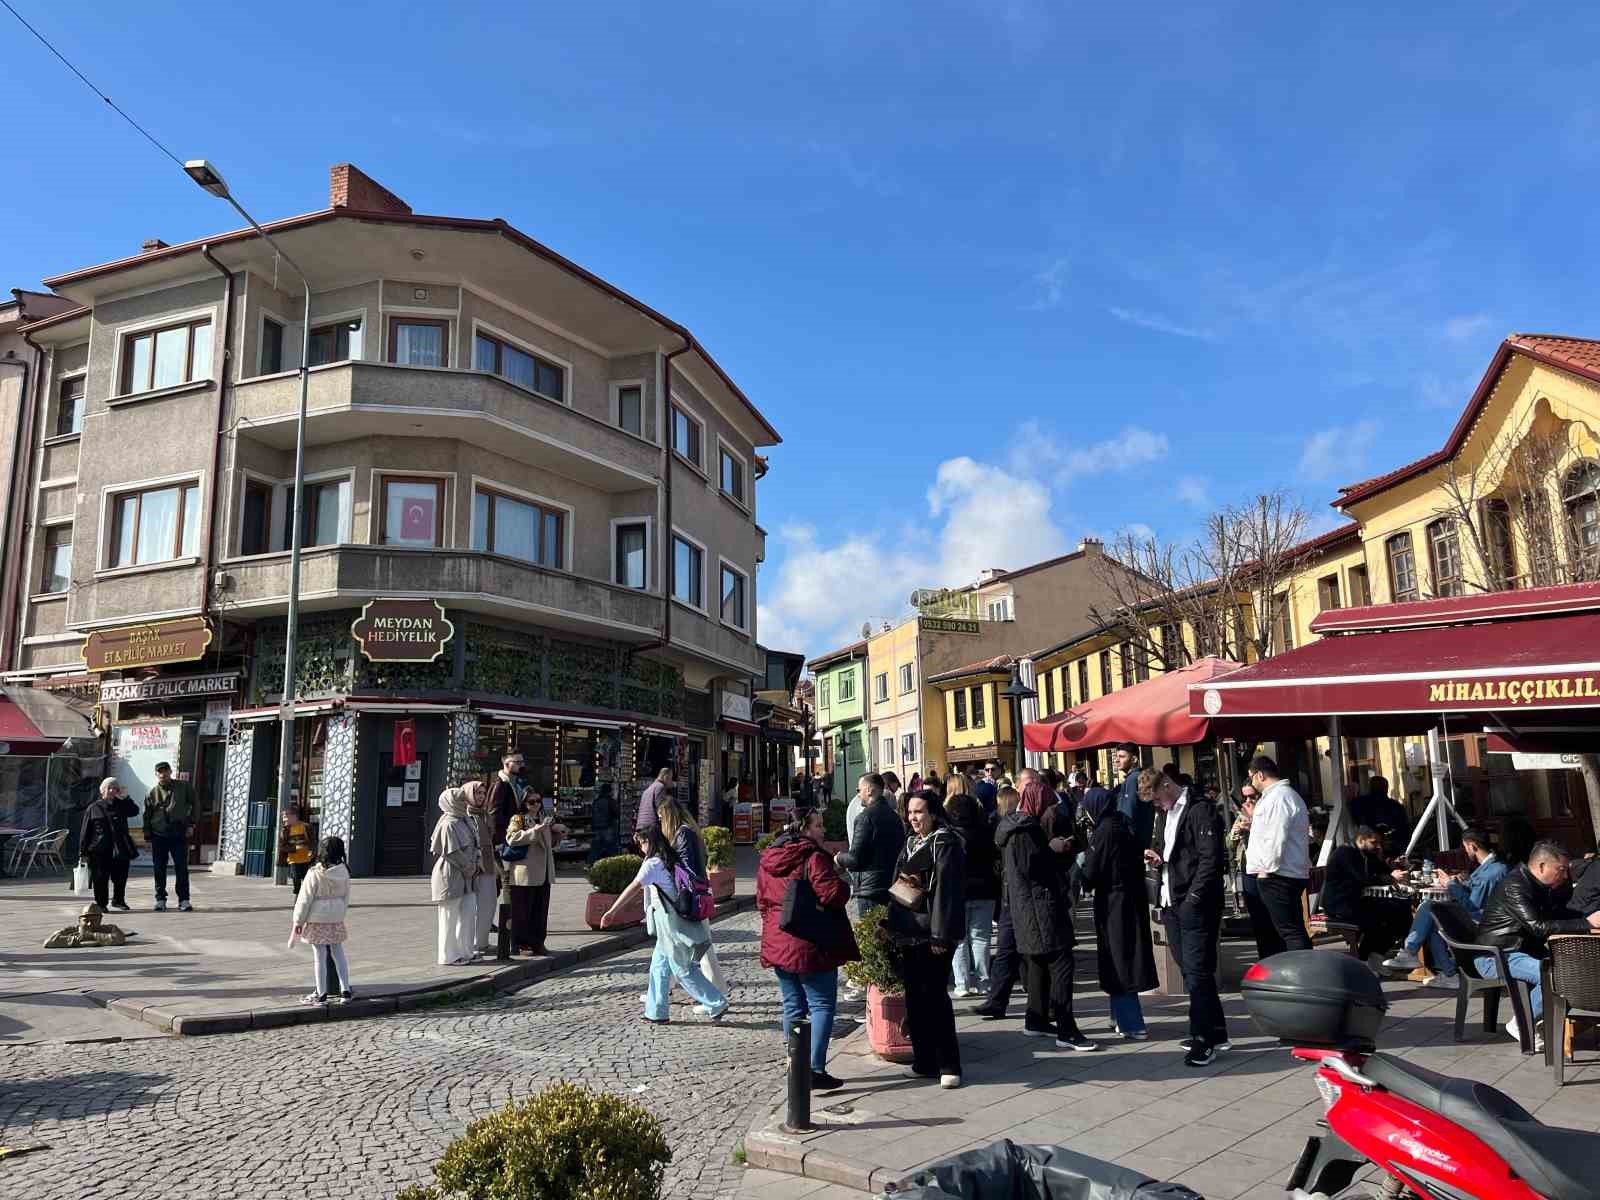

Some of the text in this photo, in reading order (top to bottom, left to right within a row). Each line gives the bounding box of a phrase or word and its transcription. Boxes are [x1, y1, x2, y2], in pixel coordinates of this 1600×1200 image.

[374, 618, 433, 629] MEYDAN
[129, 628, 160, 645] BAŞAK
[368, 629, 436, 642] HEDİYELİK
[104, 650, 114, 664] ET
[115, 650, 122, 664] &
[148, 641, 186, 658] MARKET
[142, 684, 157, 697] ET
[188, 677, 237, 692] MARKET
[1429, 678, 1600, 704] MİHALIÇÇIKLIL
